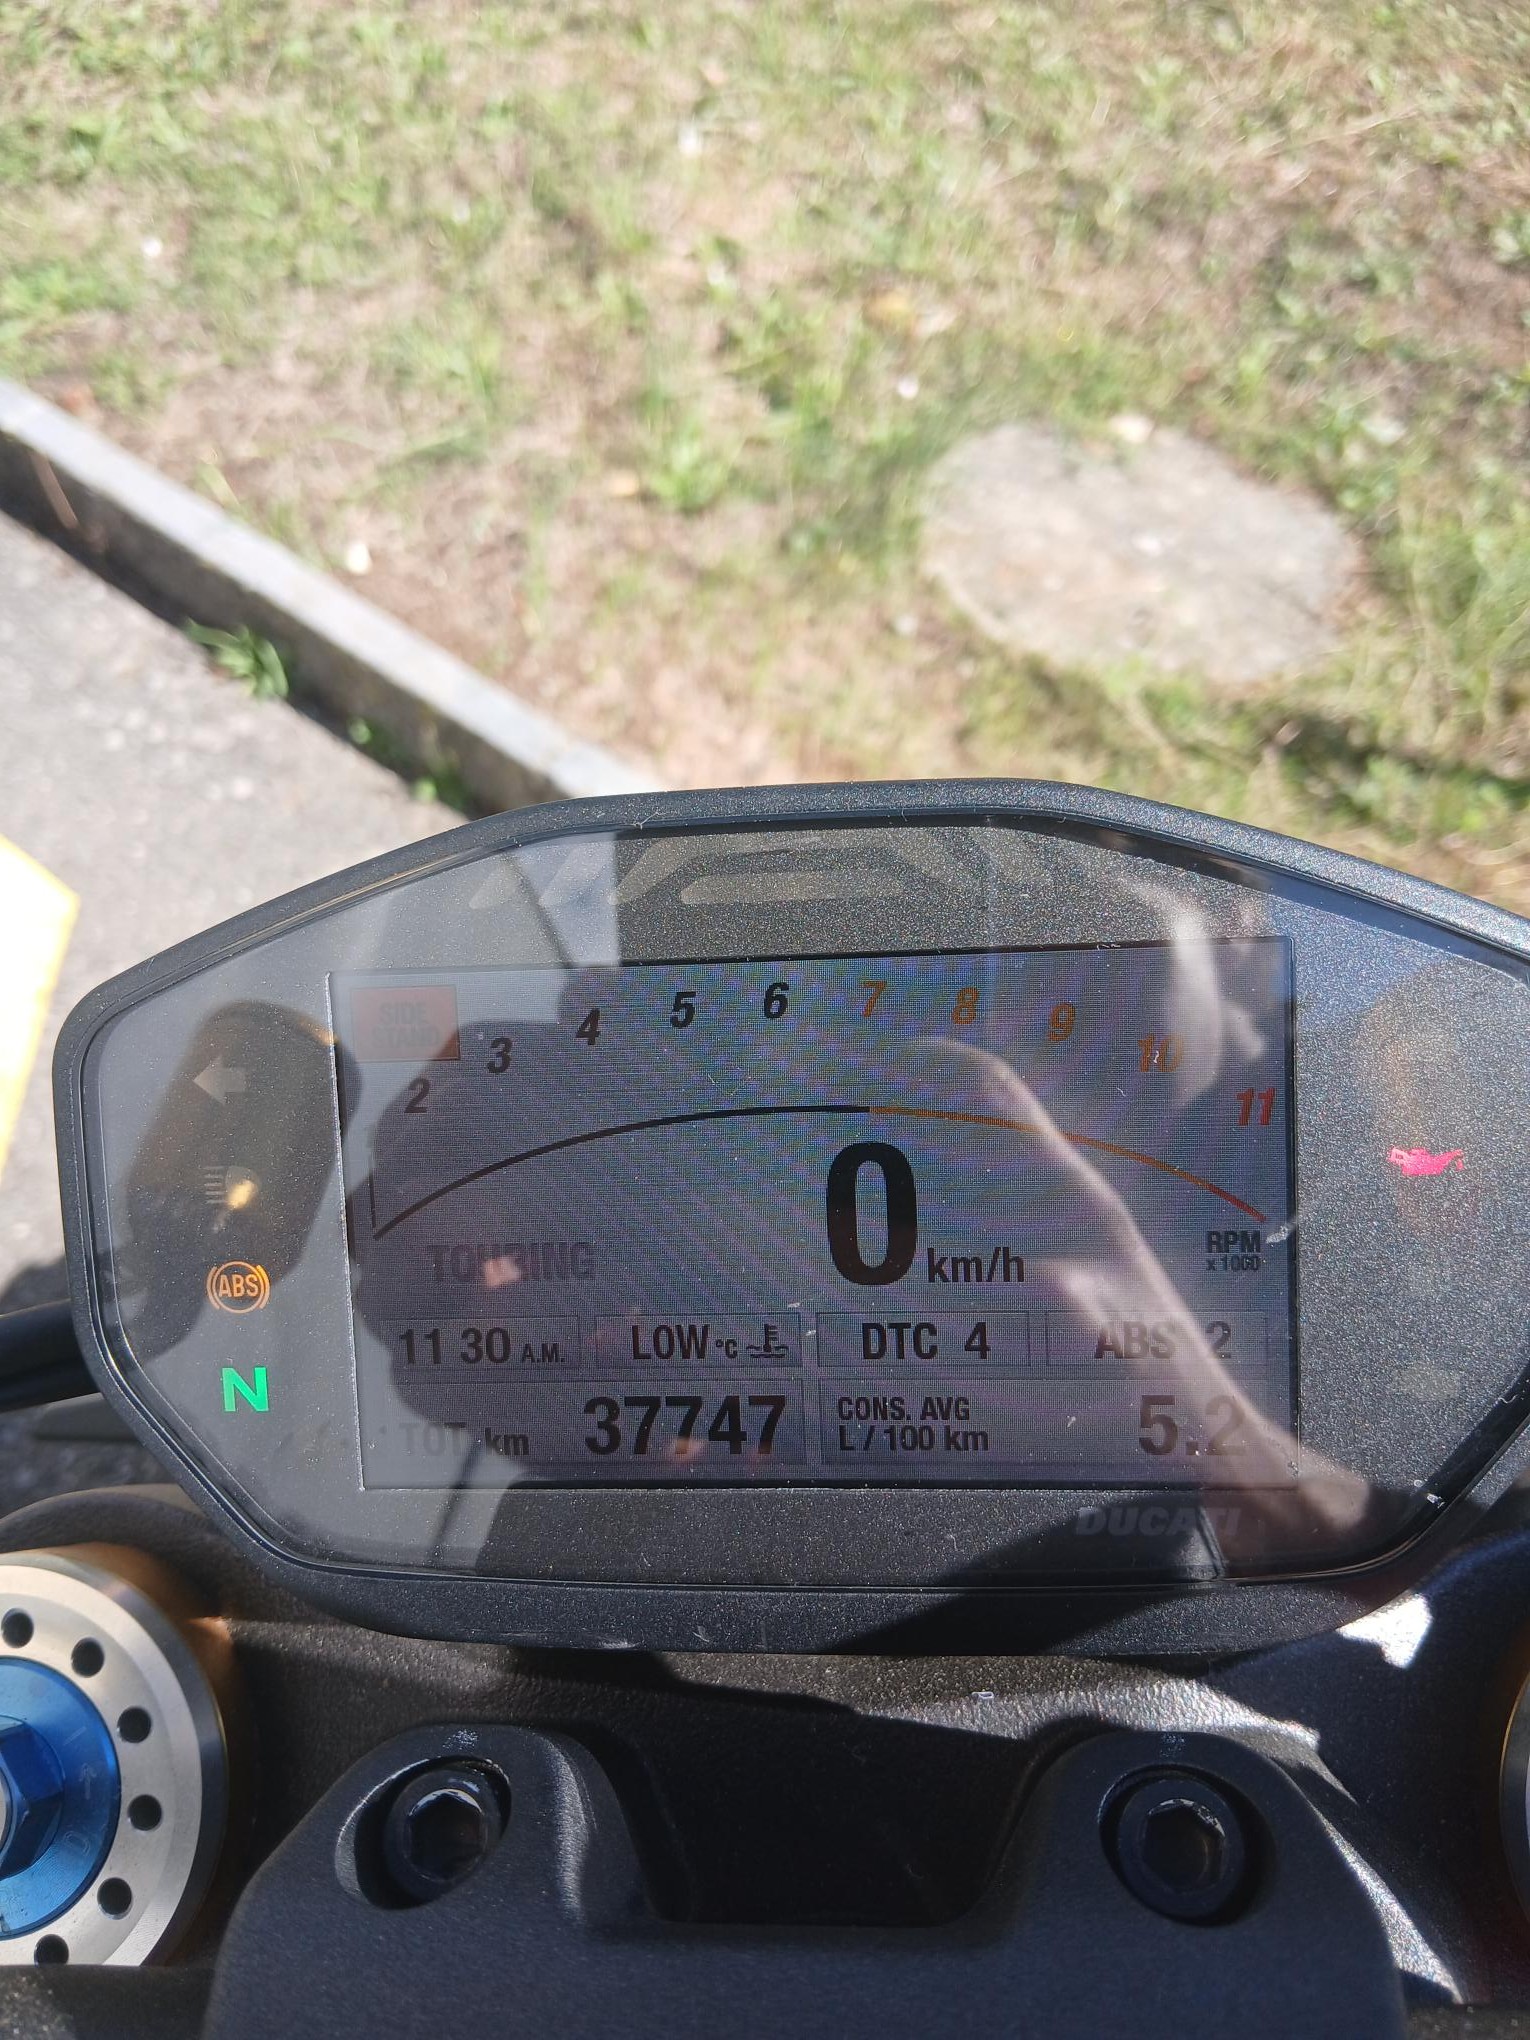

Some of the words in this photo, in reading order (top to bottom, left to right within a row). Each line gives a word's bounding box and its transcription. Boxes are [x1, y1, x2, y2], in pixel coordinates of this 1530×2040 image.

[669, 991, 696, 1029] 5
[763, 981, 790, 1019] 6
[861, 980, 886, 1017] 7
[951, 987, 979, 1024] 8
[576, 1008, 601, 1046] 4
[1048, 1003, 1076, 1041] 9
[487, 1037, 513, 1073] 3
[1137, 1035, 1183, 1073] 10
[404, 1077, 431, 1113] 2
[1235, 1087, 1276, 1126] 11
[826, 1141, 918, 1286] 0
[927, 1247, 1026, 1284] km/h
[1206, 1230, 1261, 1253] RPM
[218, 1274, 259, 1299] ABS
[520, 1342, 566, 1364] A.M.
[631, 1323, 709, 1360] LOW
[861, 1321, 938, 1360] DTC
[964, 1321, 991, 1360] 4
[1093, 1320, 1177, 1360] ABS
[1205, 1320, 1233, 1360] 2
[221, 1366, 269, 1412] N
[583, 1394, 787, 1456] 37747
[837, 1396, 912, 1422] CONS.
[920, 1396, 971, 1421] AVG
[1138, 1394, 1247, 1457] 5.2
[398, 1420, 468, 1457] TOT
[484, 1426, 530, 1456] km
[944, 1424, 989, 1451] km
[1074, 1505, 1243, 1537] DUCATI
